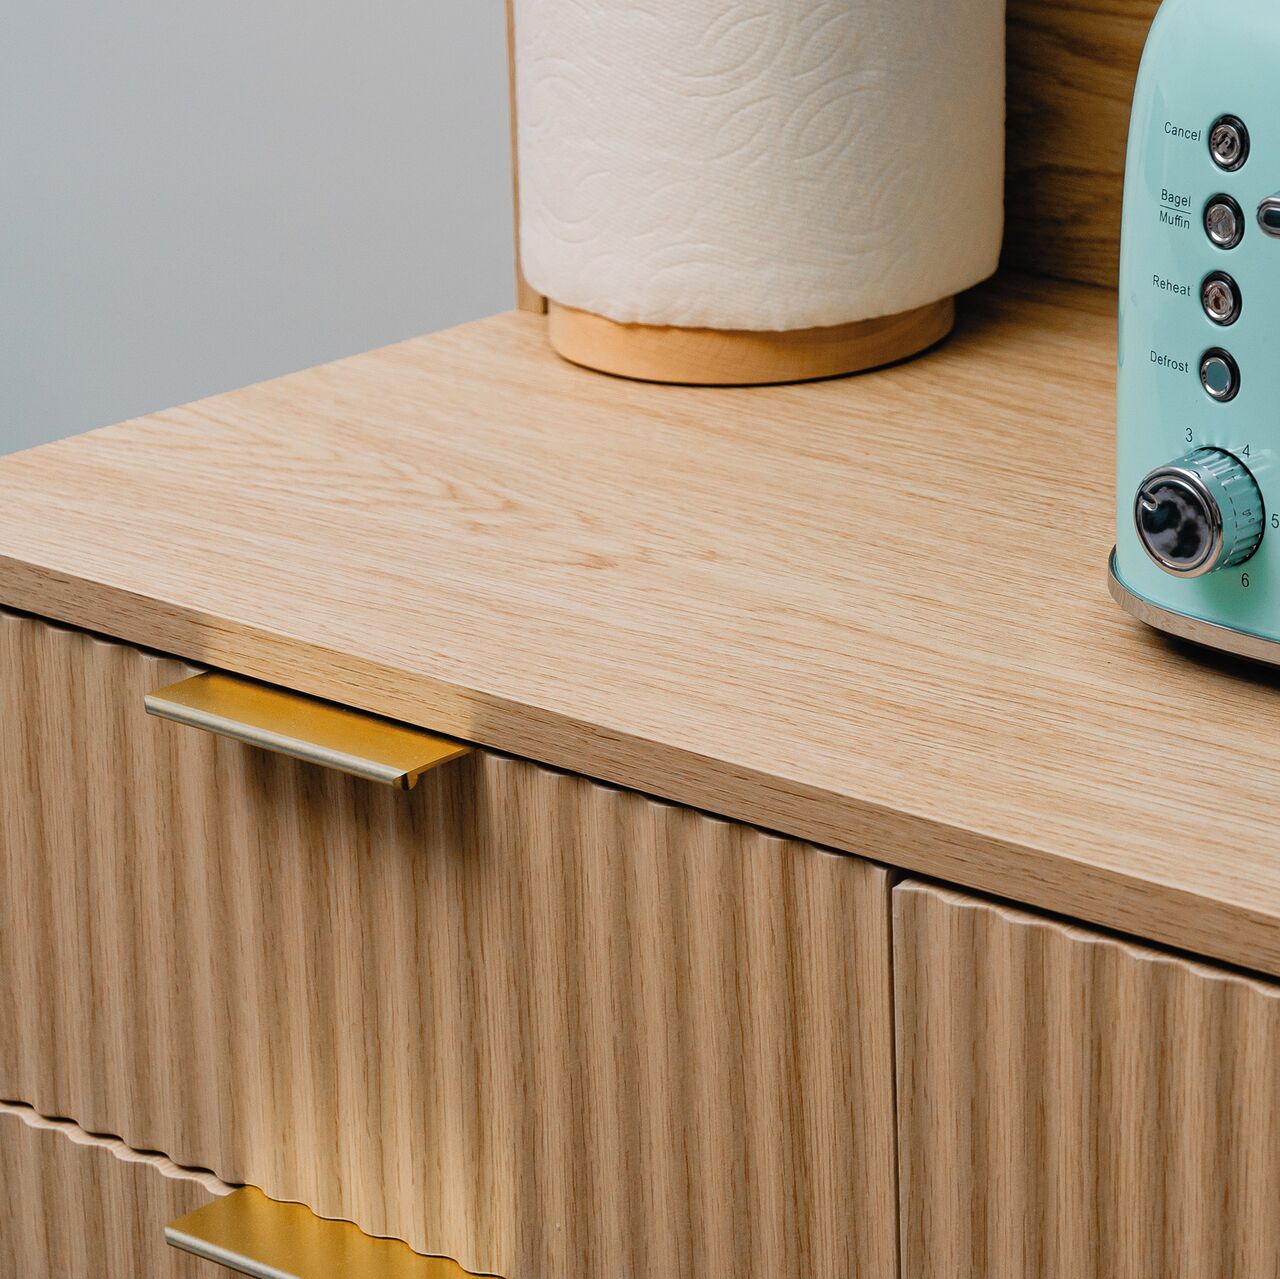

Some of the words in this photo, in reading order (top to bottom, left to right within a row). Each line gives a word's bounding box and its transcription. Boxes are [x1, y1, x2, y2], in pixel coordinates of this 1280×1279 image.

[1163, 121, 1202, 142] Cancel
[1160, 188, 1192, 208] Bagel
[1158, 210, 1191, 230] Muffin
[1152, 275, 1192, 298] Reheat
[1149, 351, 1190, 374] Defrost
[1185, 428, 1193, 443] 3
[1242, 444, 1251, 459] 4
[1271, 514, 1280, 529] 5
[1241, 572, 1250, 588] 6
